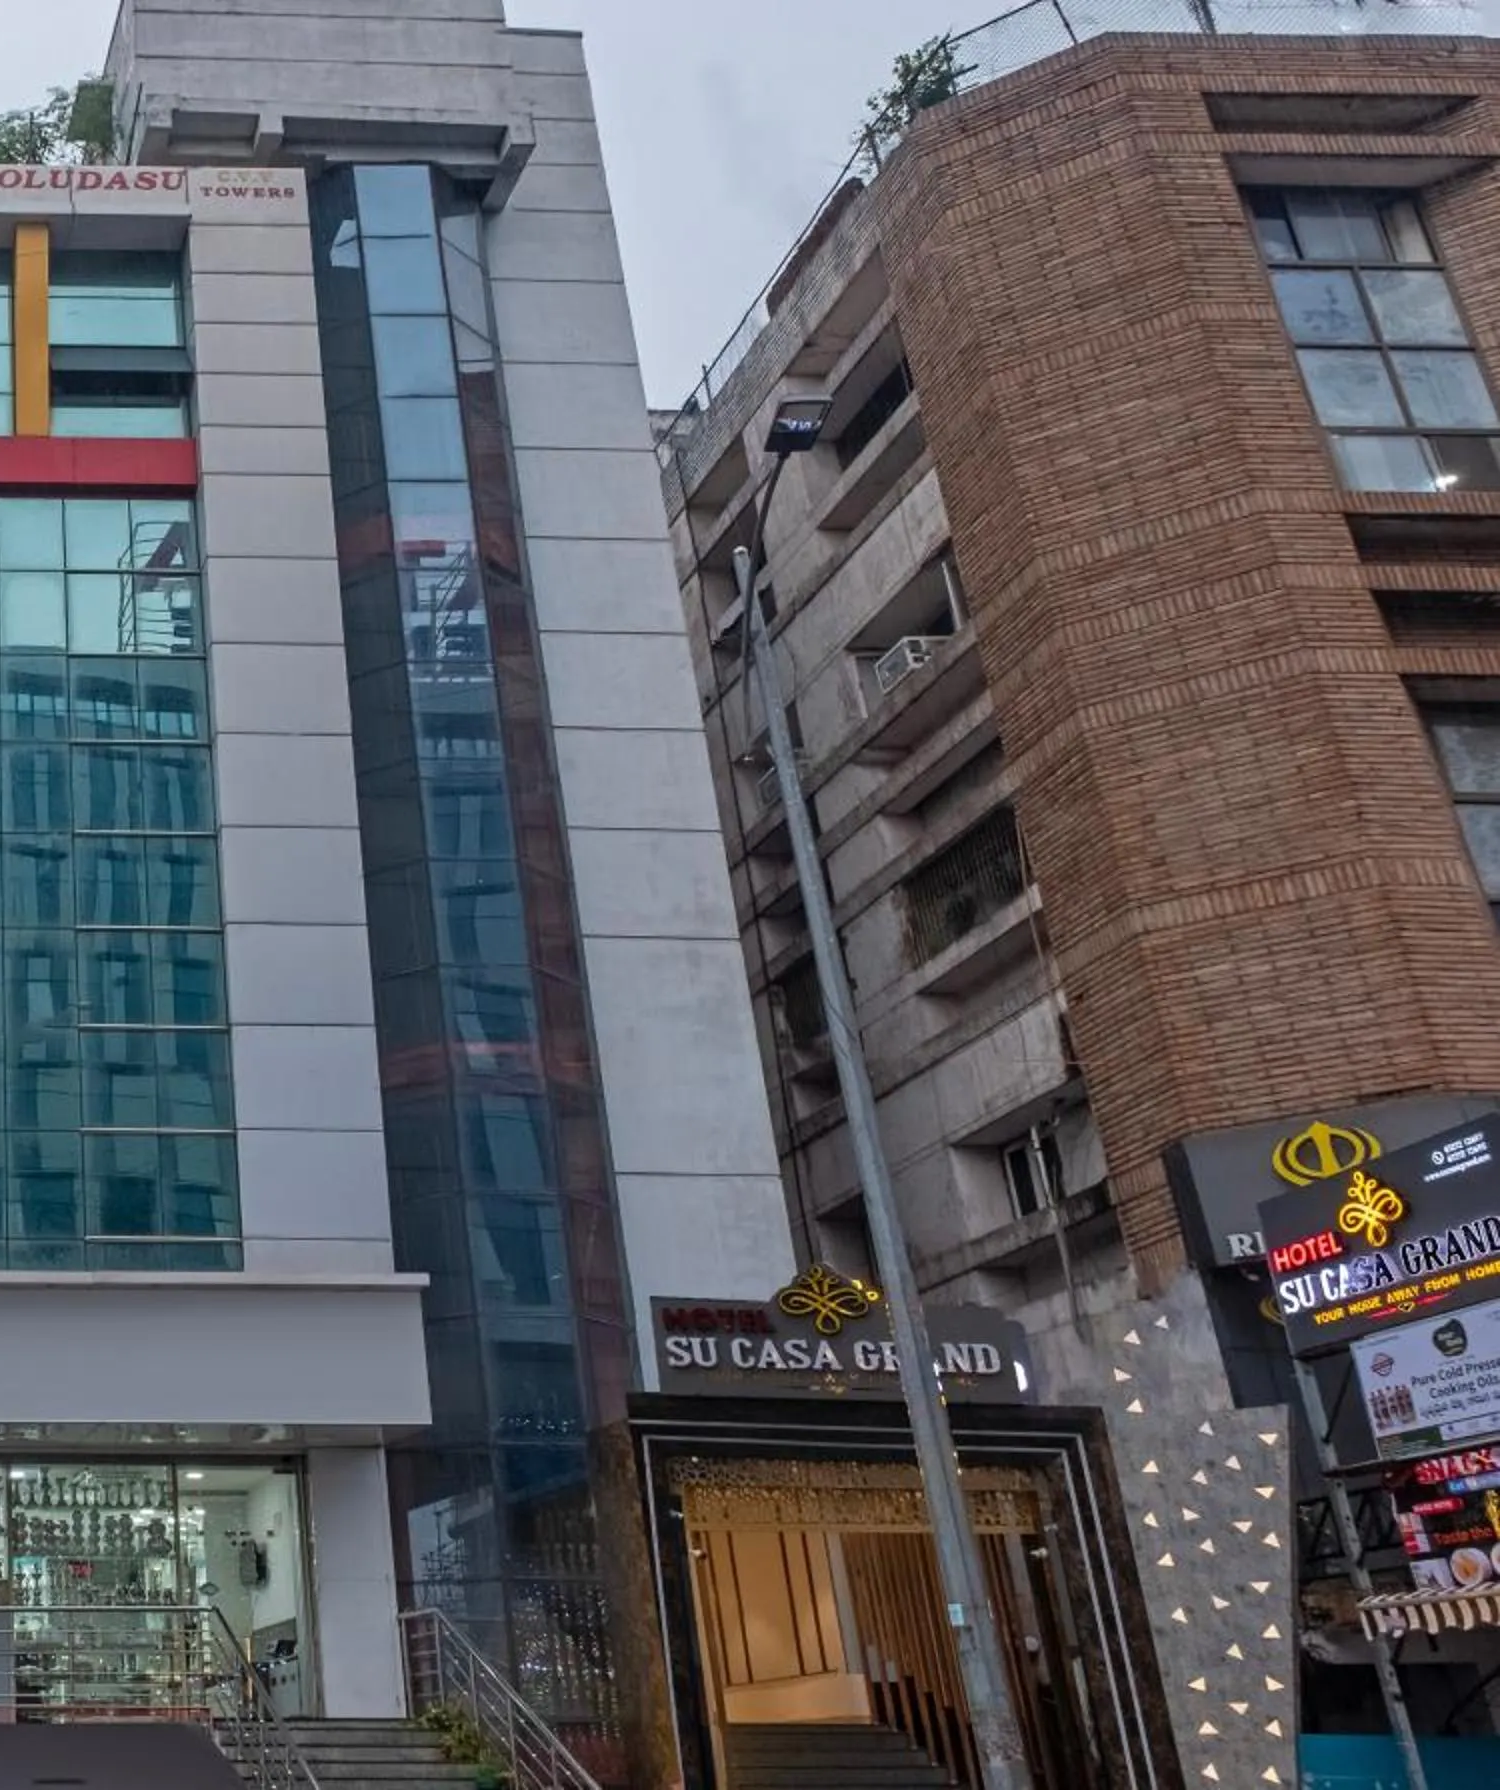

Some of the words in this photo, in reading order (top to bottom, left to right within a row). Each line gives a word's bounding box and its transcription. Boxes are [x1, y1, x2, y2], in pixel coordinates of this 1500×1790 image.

[201, 186, 296, 198] TOWERS
[1272, 1231, 1343, 1273] HOTEL
[1280, 1275, 1316, 1314] SU
[1320, 1253, 1395, 1301] CASA
[1400, 1216, 1500, 1276] GRAND
[1313, 1306, 1345, 1325] YOUR
[1386, 1284, 1420, 1304] AWAY
[1423, 1272, 1461, 1294] FROM
[665, 1336, 718, 1368] SU
[731, 1338, 844, 1371] CASA
[853, 1340, 1001, 1373] GRND
[1438, 1366, 1464, 1380] Cold
[1429, 1381, 1477, 1399] Cooking
